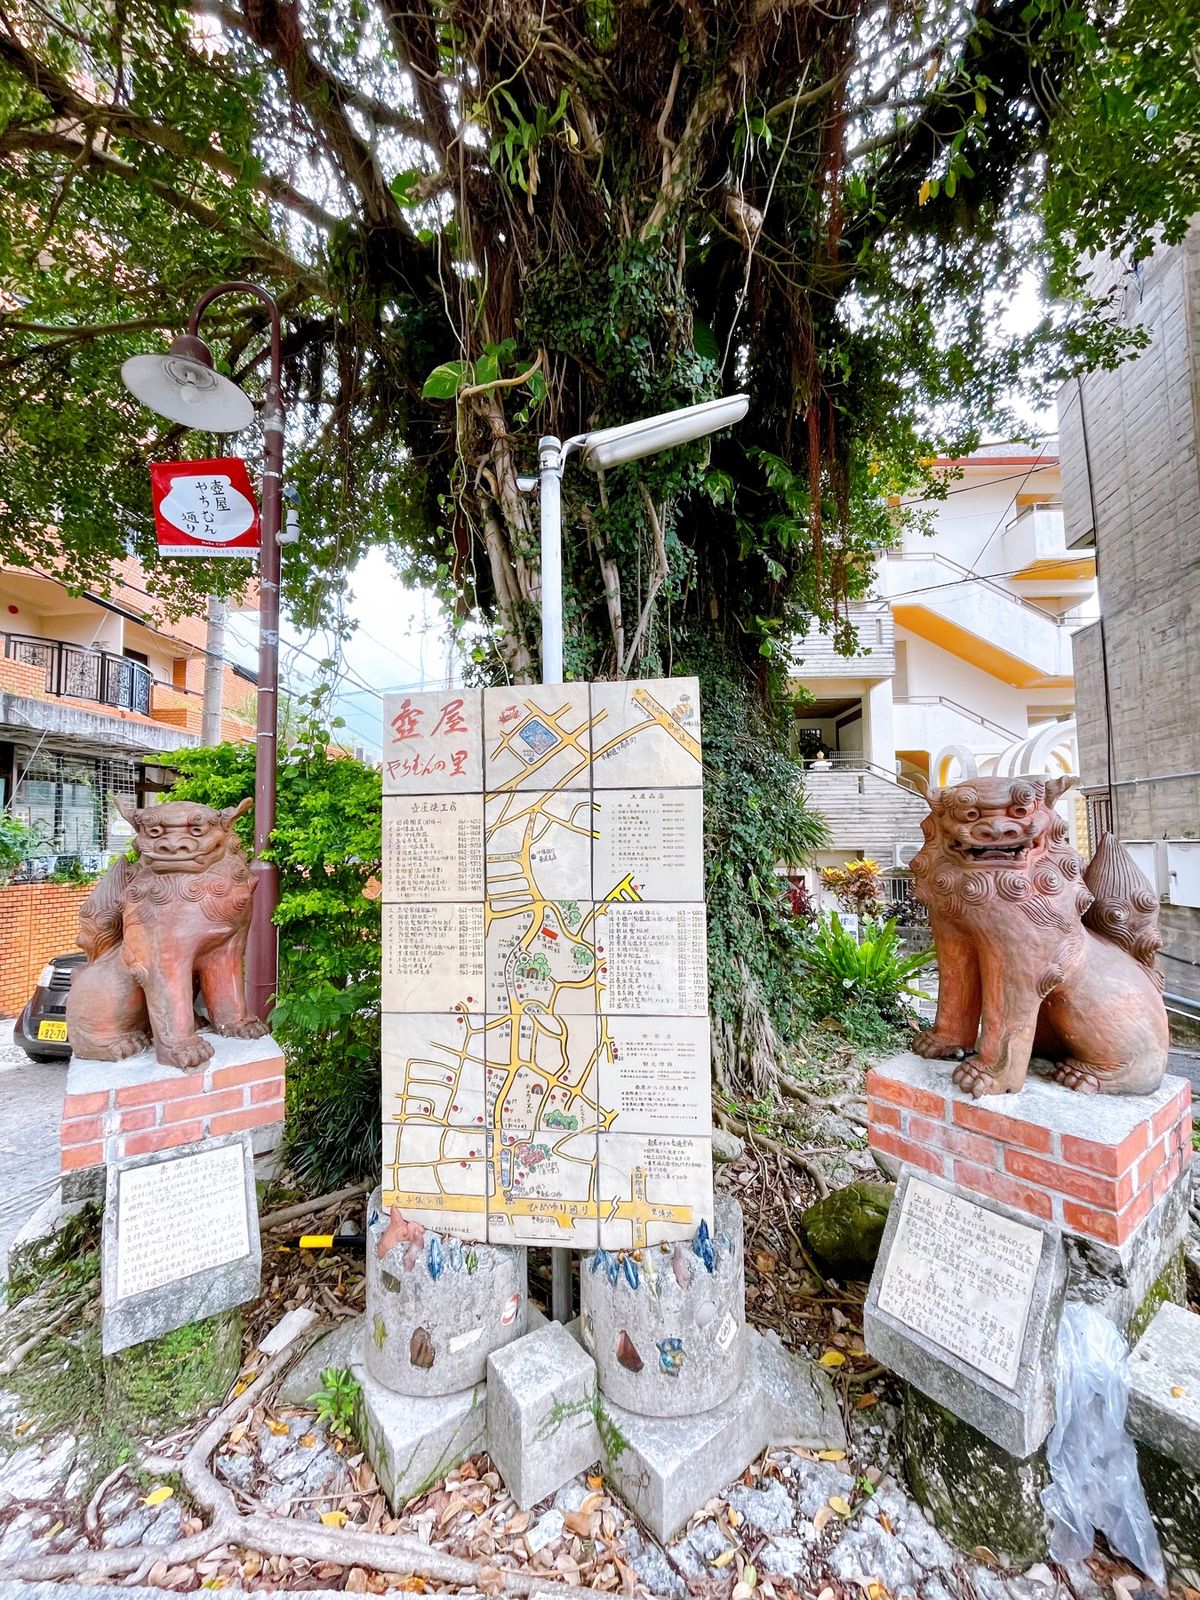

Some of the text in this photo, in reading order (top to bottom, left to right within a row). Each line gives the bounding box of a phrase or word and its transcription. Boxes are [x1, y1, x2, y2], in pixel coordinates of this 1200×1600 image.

[195, 481, 217, 535] やちむん
[210, 479, 231, 512] 壺屋
[181, 511, 200, 533] 通り
[391, 699, 468, 743] 壺屋
[386, 750, 468, 780] やちむんの里
[44, 1028, 66, 1040] 82-70
